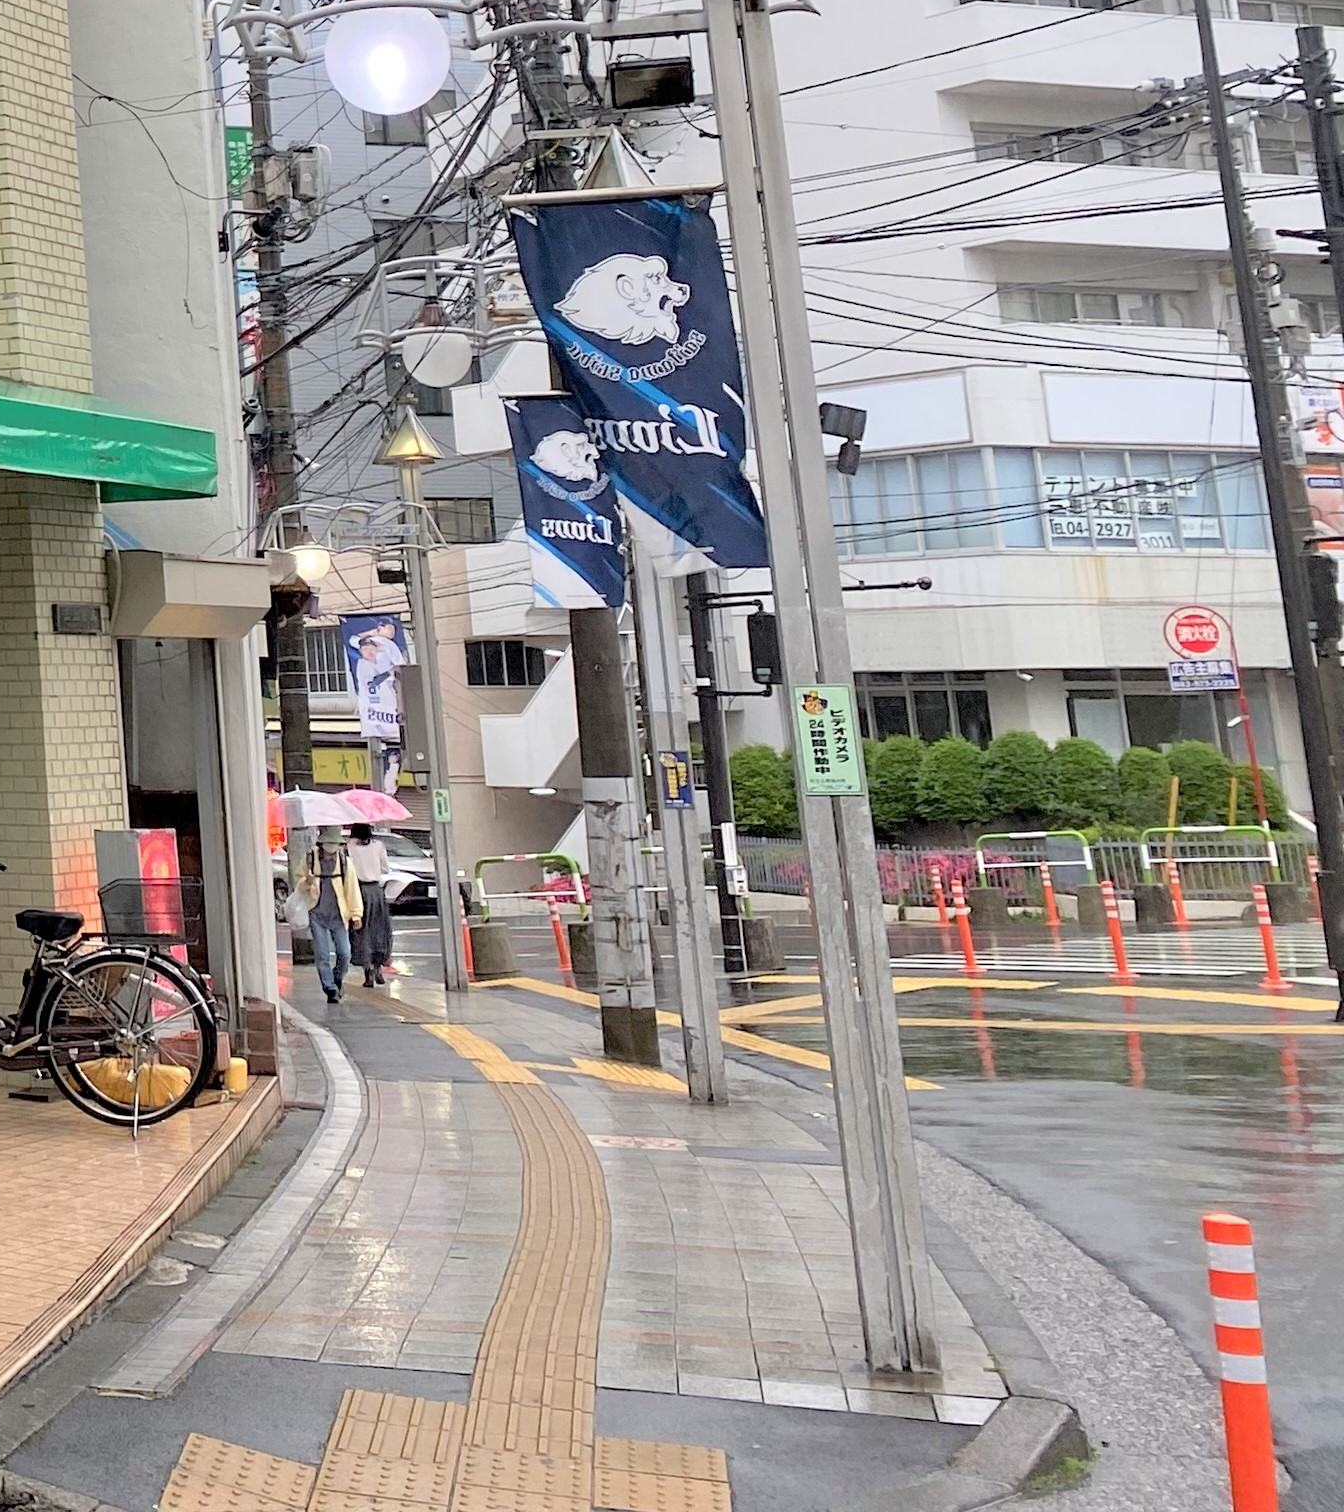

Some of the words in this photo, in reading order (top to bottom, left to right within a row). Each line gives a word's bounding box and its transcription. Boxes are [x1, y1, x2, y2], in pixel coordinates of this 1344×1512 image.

[1176, 624, 1218, 642] 消火栓
[809, 719, 830, 774] 24時間作動中
[830, 709, 850, 763] ビデオカメラ
